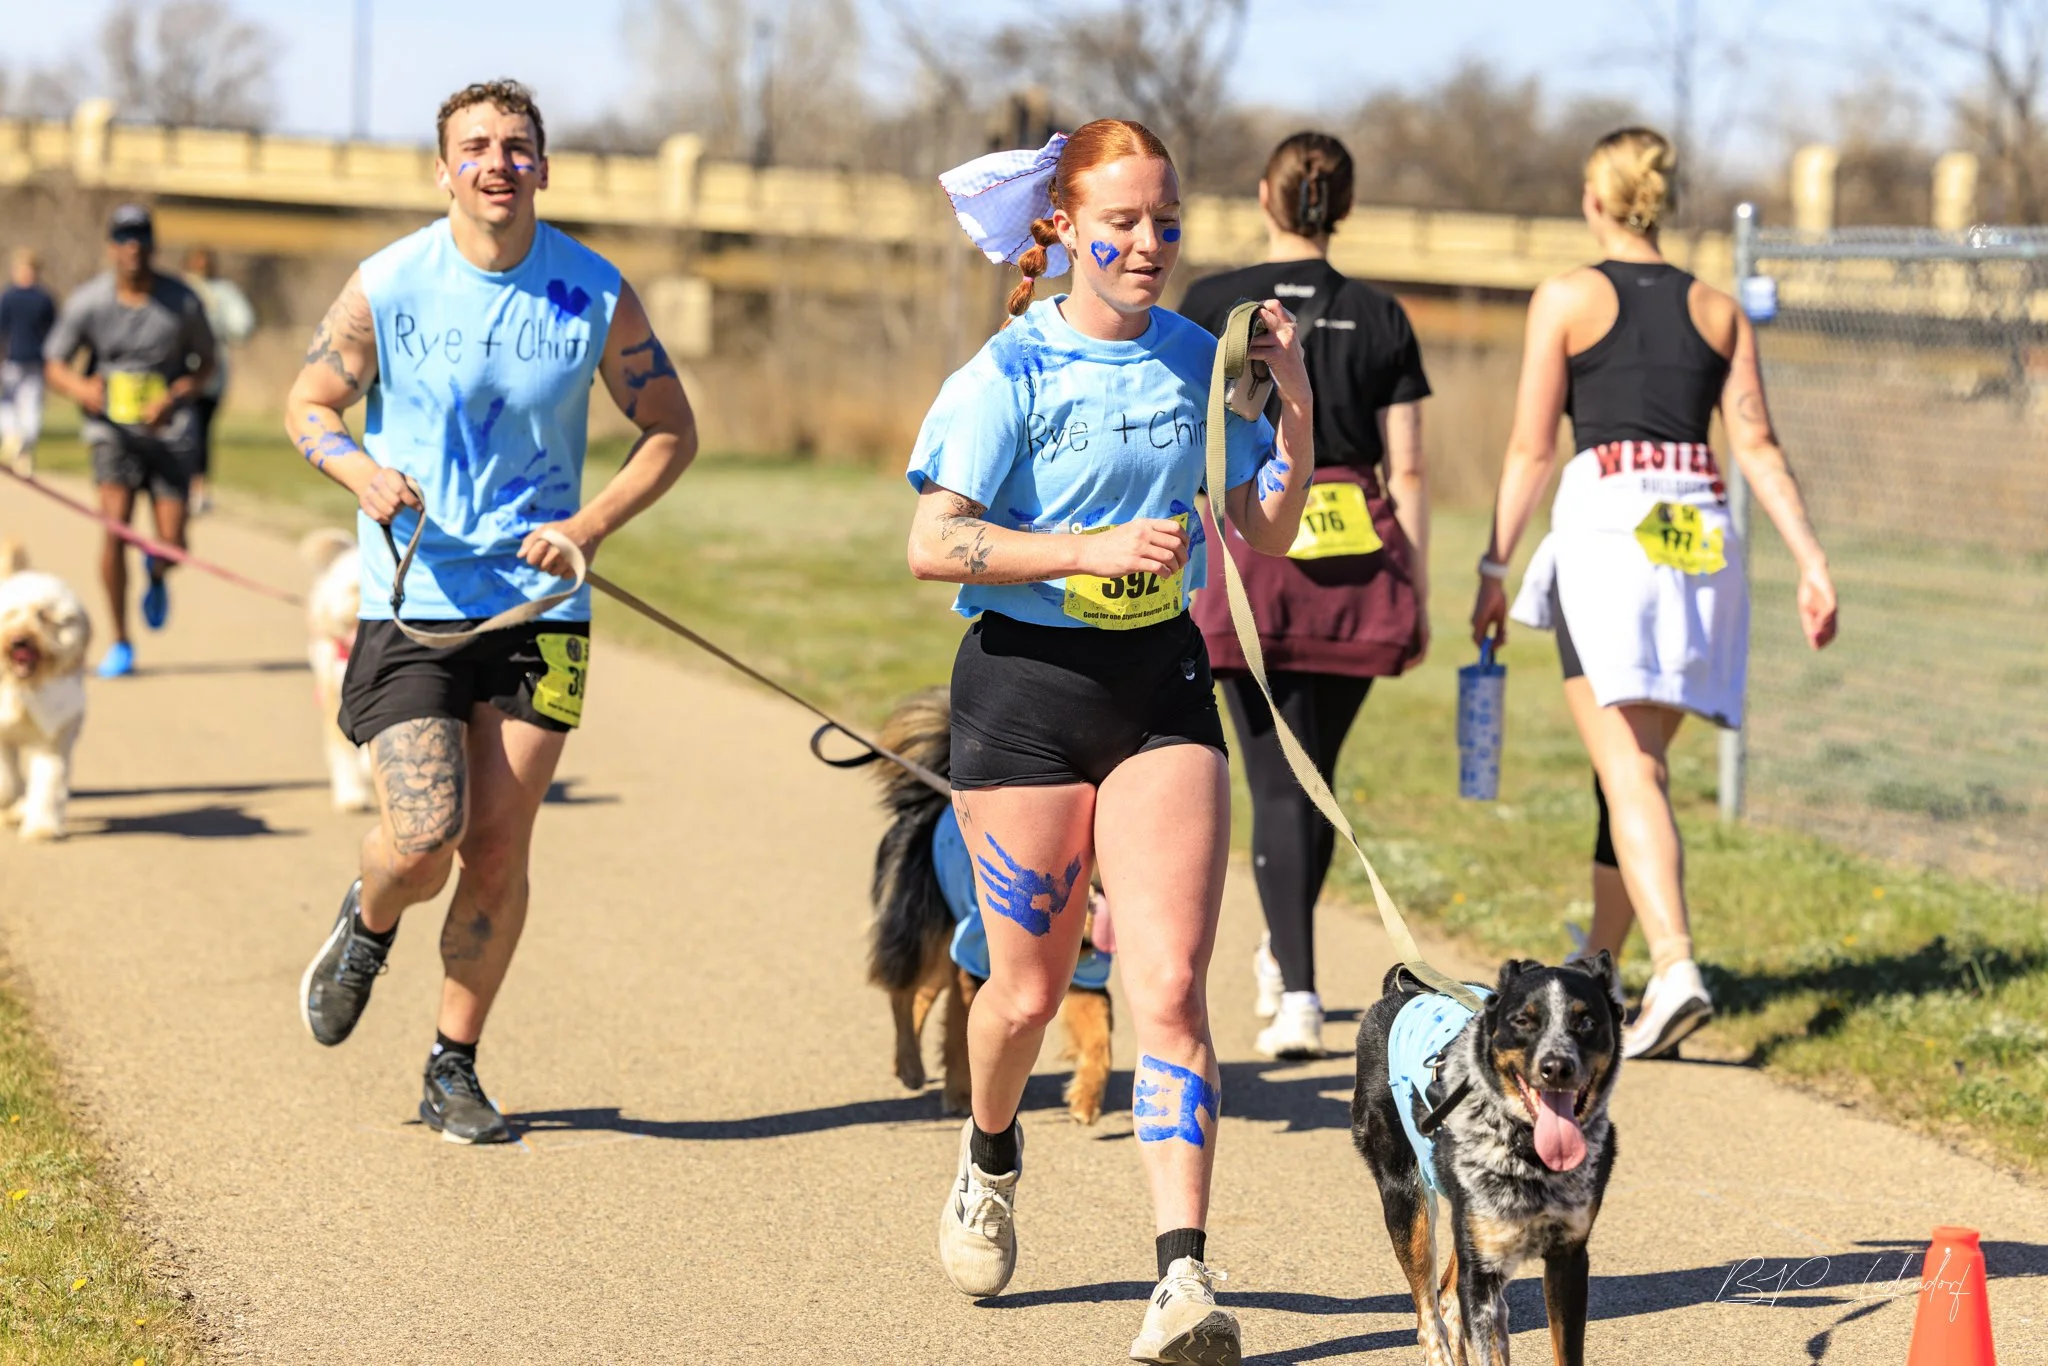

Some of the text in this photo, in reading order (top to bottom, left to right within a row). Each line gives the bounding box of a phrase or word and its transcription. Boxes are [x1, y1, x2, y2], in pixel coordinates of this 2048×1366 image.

[395, 313, 462, 372] Rye
[1026, 412, 1089, 464] Rye
[1113, 413, 1137, 444] +
[1305, 510, 1346, 533] 176
[1083, 611, 1099, 619] Good
[1100, 612, 1109, 620] for
